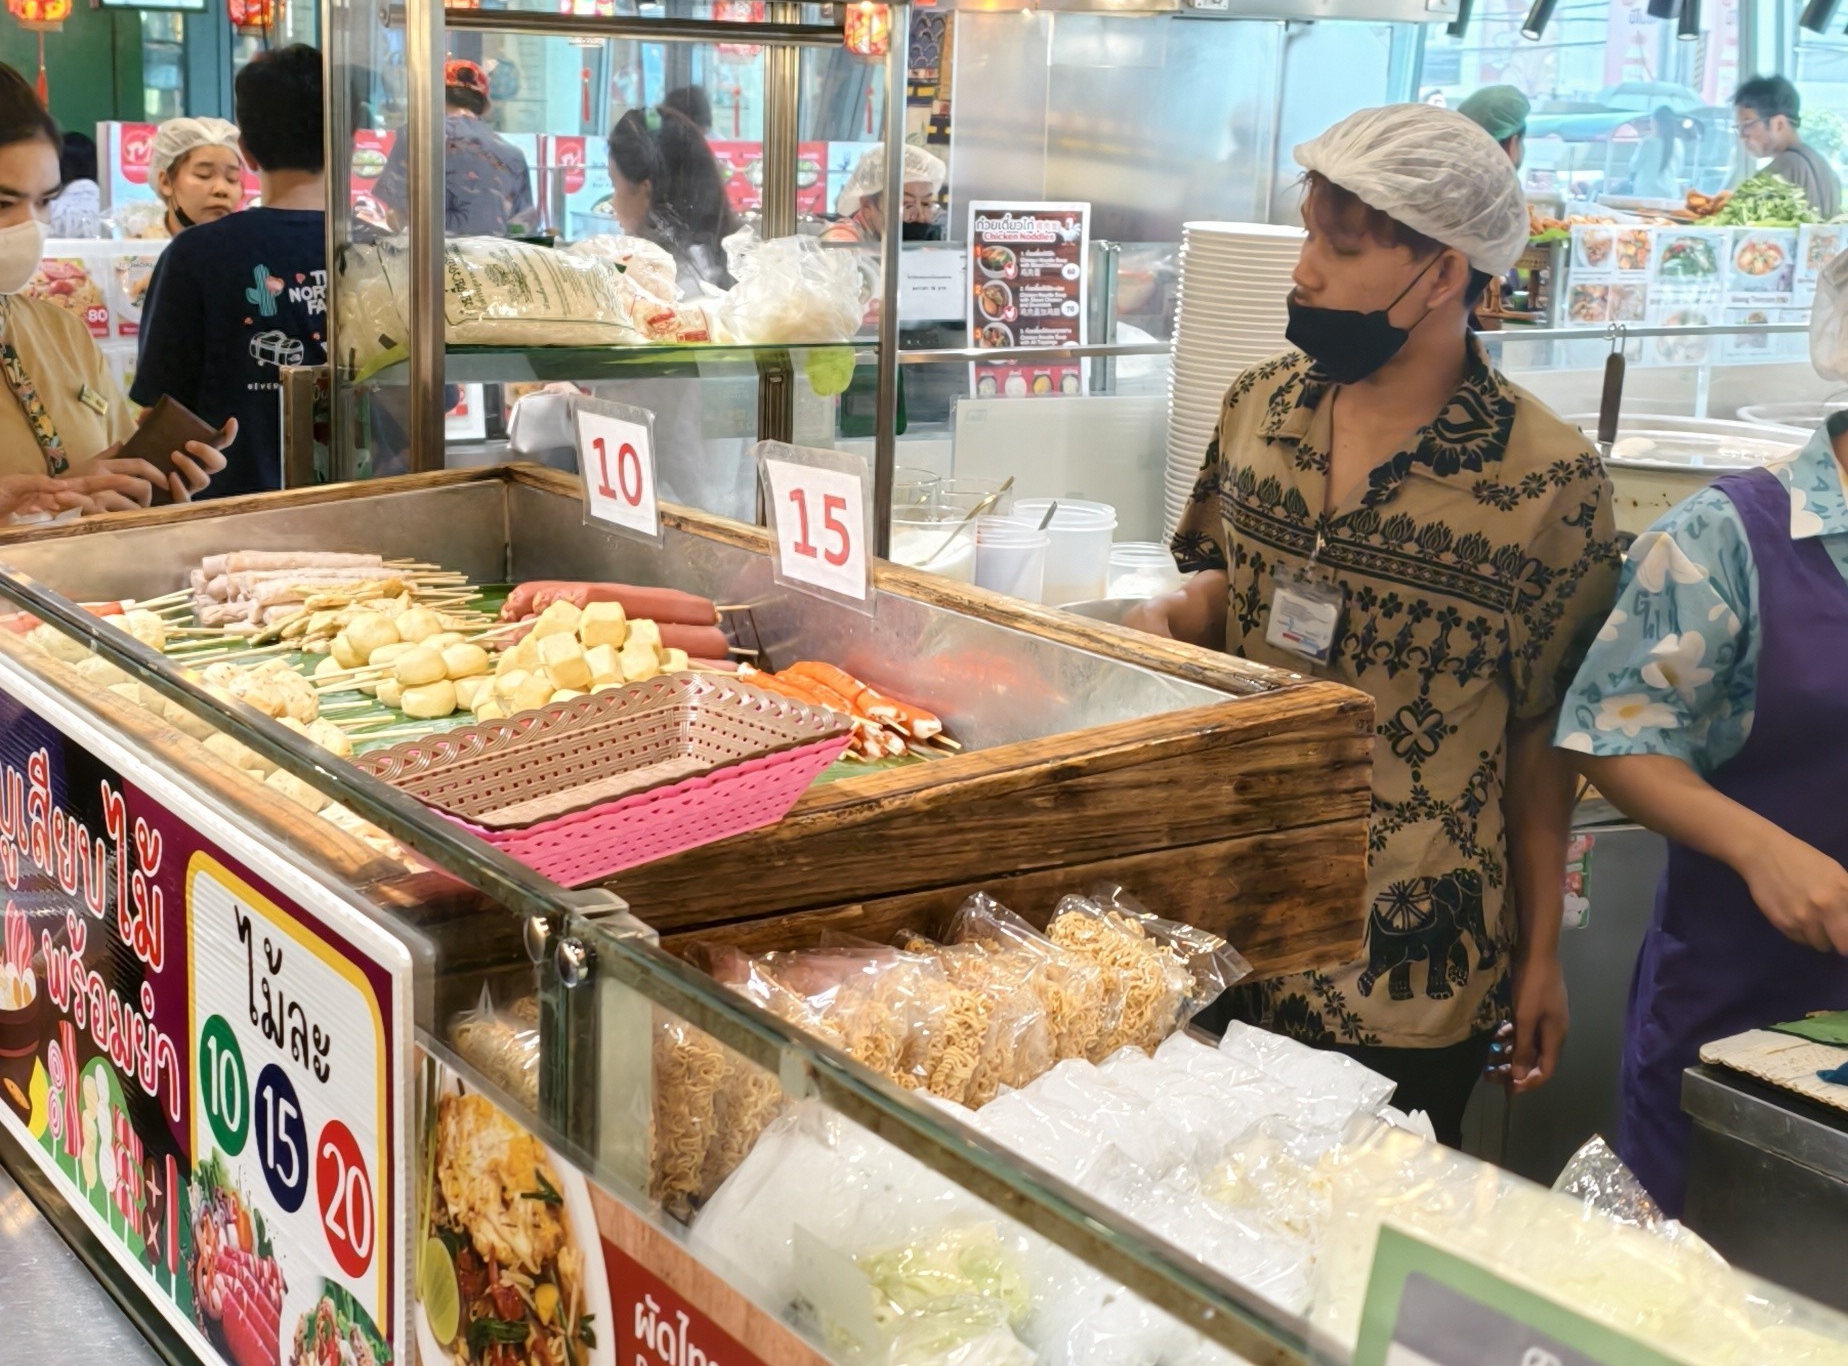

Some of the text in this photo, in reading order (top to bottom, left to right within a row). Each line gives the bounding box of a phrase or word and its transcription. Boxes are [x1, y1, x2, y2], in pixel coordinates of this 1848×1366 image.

[984, 233, 1055, 241] Chicken Noodles
[88, 308, 108, 322] 80
[289, 285, 327, 303] NOR
[593, 437, 643, 506] 10
[789, 488, 850, 567] 15
[42, 908, 181, 1123] พร้อมยำ
[234, 905, 331, 1083] ไม้ละ
[207, 1035, 242, 1133] 10
[262, 1091, 300, 1188] 15
[322, 1142, 371, 1259] 20
